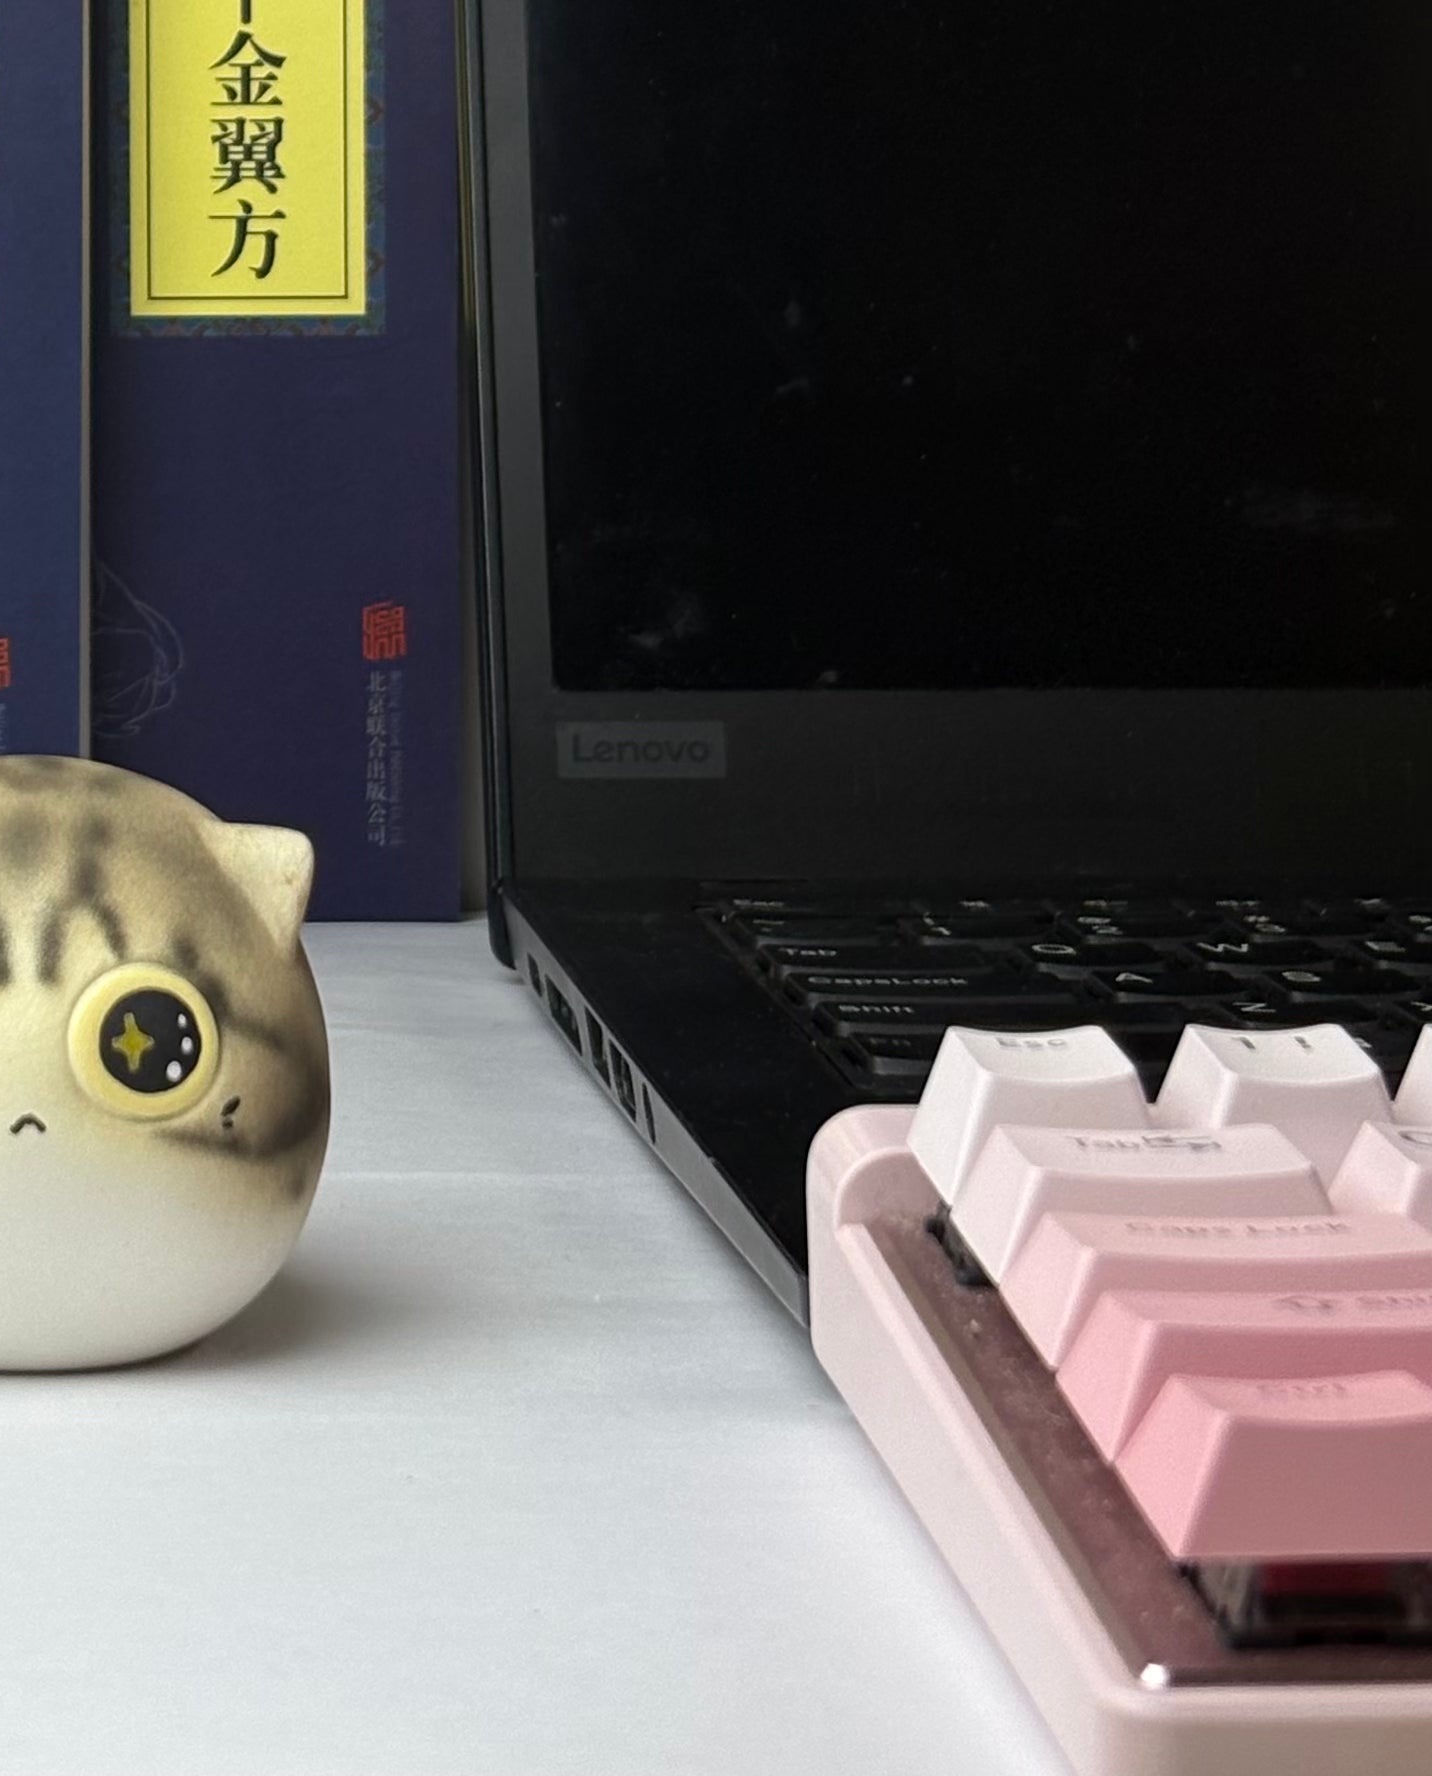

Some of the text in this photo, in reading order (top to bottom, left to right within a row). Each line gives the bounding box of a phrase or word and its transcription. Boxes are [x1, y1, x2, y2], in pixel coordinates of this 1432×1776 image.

[571, 733, 711, 764] Lenovo
[365, 670, 388, 848] 北京联合出版公司
[778, 946, 837, 957] Tab
[807, 975, 968, 986] CapsLock
[838, 1004, 913, 1014] Shift
[994, 1035, 1068, 1050] Esc
[1065, 1134, 1141, 1150] Tab
